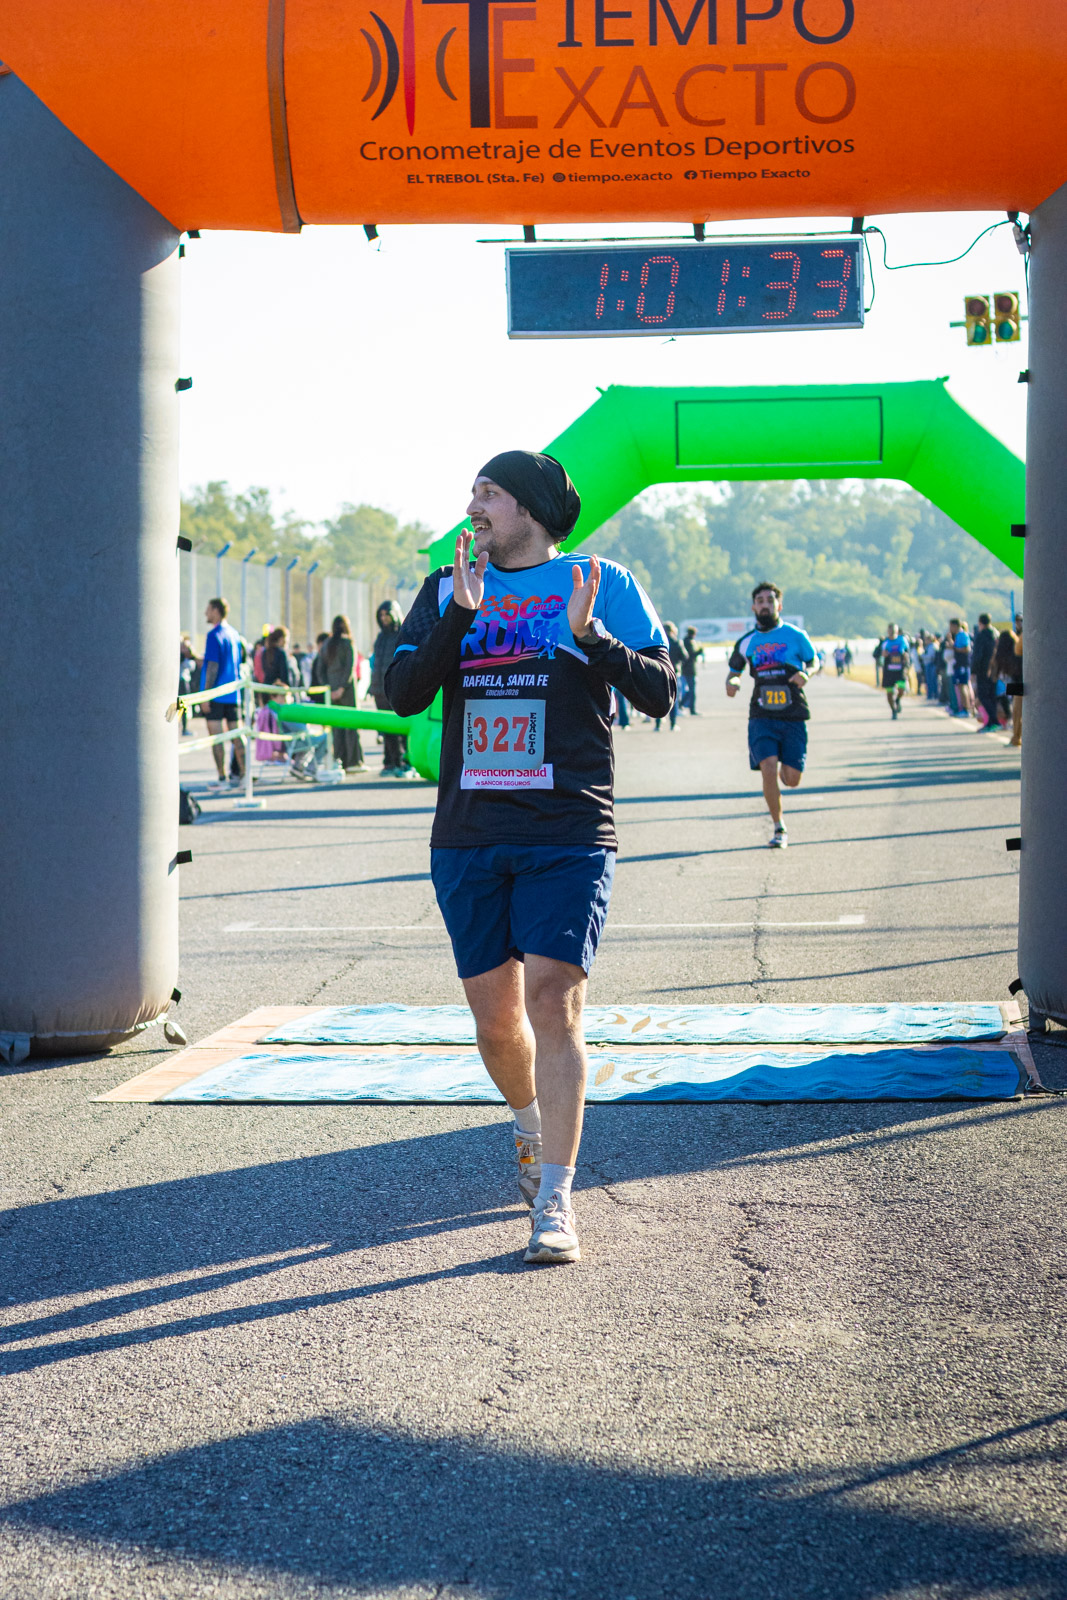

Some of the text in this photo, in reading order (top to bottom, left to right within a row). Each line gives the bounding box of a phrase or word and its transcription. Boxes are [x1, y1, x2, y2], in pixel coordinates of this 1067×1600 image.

[360, 135, 855, 164] Cronometraje de Eventos Deportivos
[407, 174, 424, 184] EL
[426, 173, 484, 184] TREBOL
[487, 173, 520, 185] (Sta.
[523, 172, 545, 184] Fe)
[701, 168, 811, 181] Tiempo Exacto
[532, 603, 566, 611] MILLAS
[462, 674, 549, 688] RAFAELA, SANTA FE
[766, 690, 787, 705] 713
[466, 712, 474, 756] TIEMPO
[473, 716, 530, 753] 327
[527, 712, 537, 756] EXACTO
